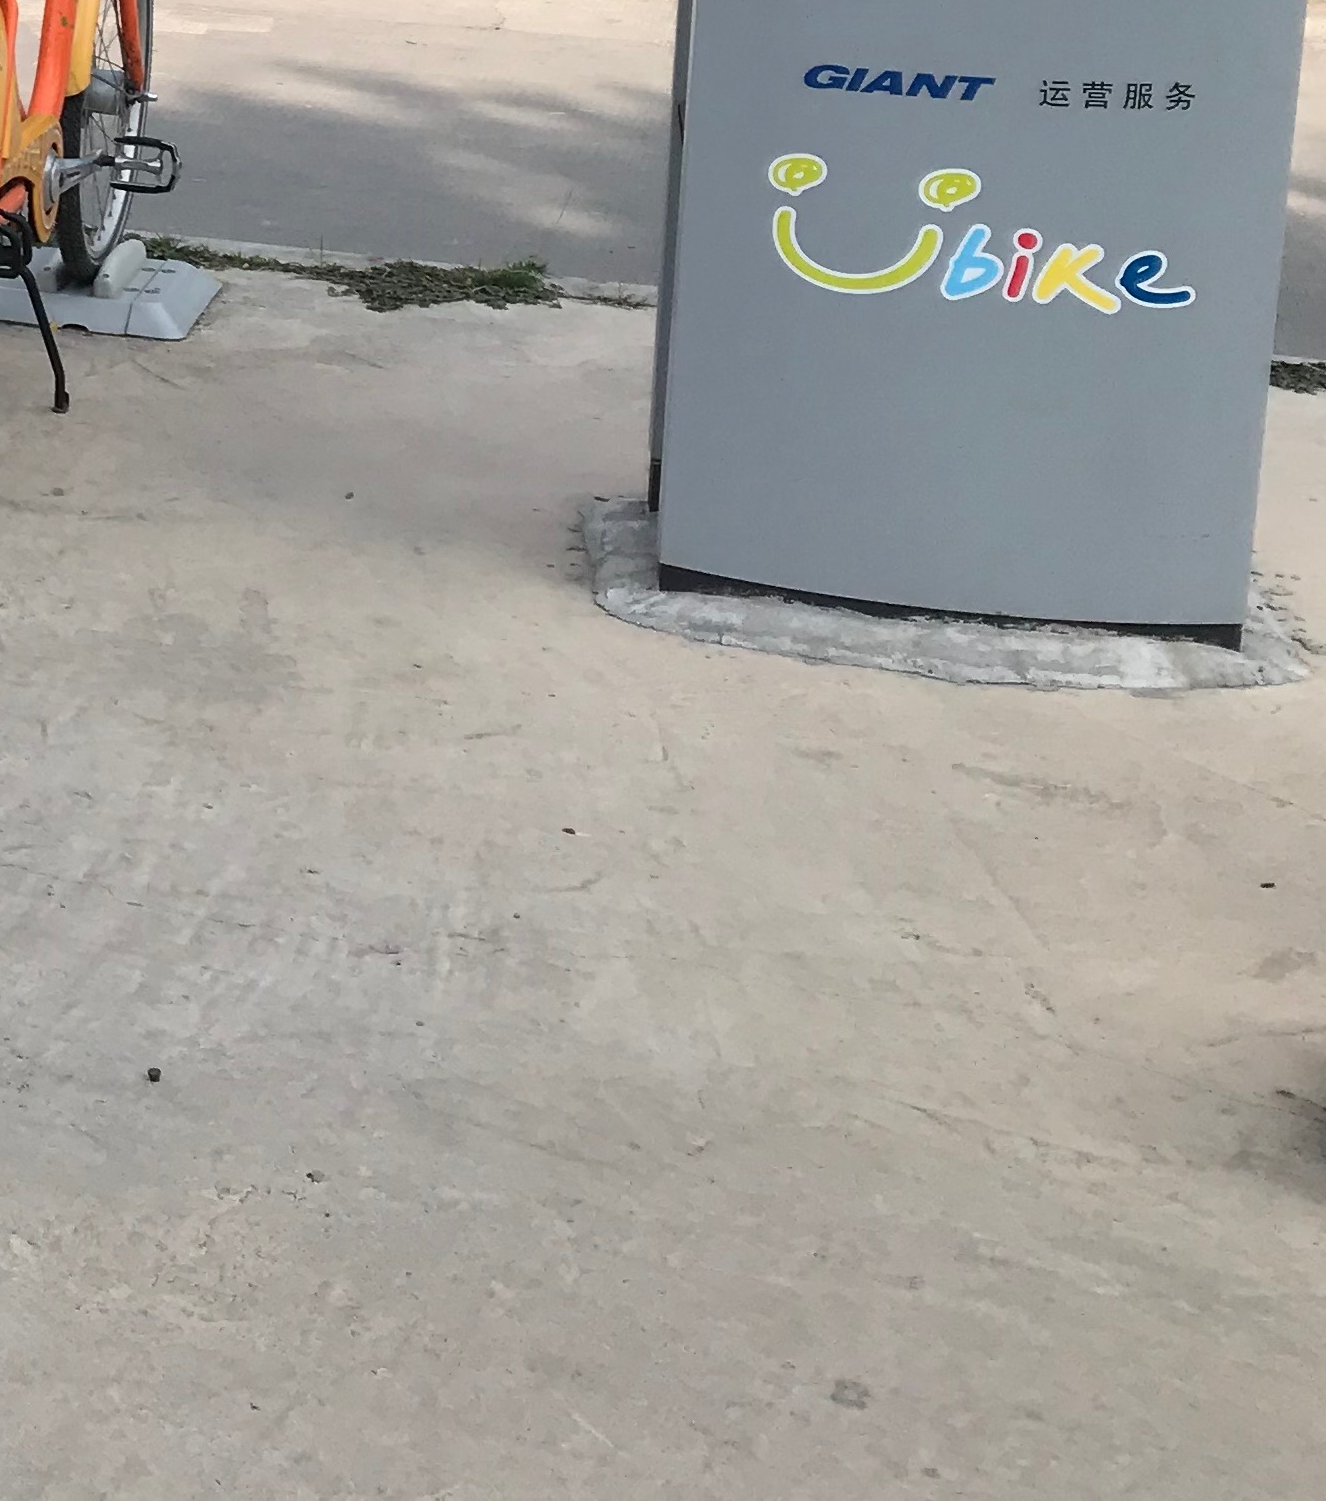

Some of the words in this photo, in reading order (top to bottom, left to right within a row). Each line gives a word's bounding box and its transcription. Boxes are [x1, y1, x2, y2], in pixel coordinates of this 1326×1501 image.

[804, 64, 996, 101] GIANT
[1039, 79, 1197, 111] 运营服务
